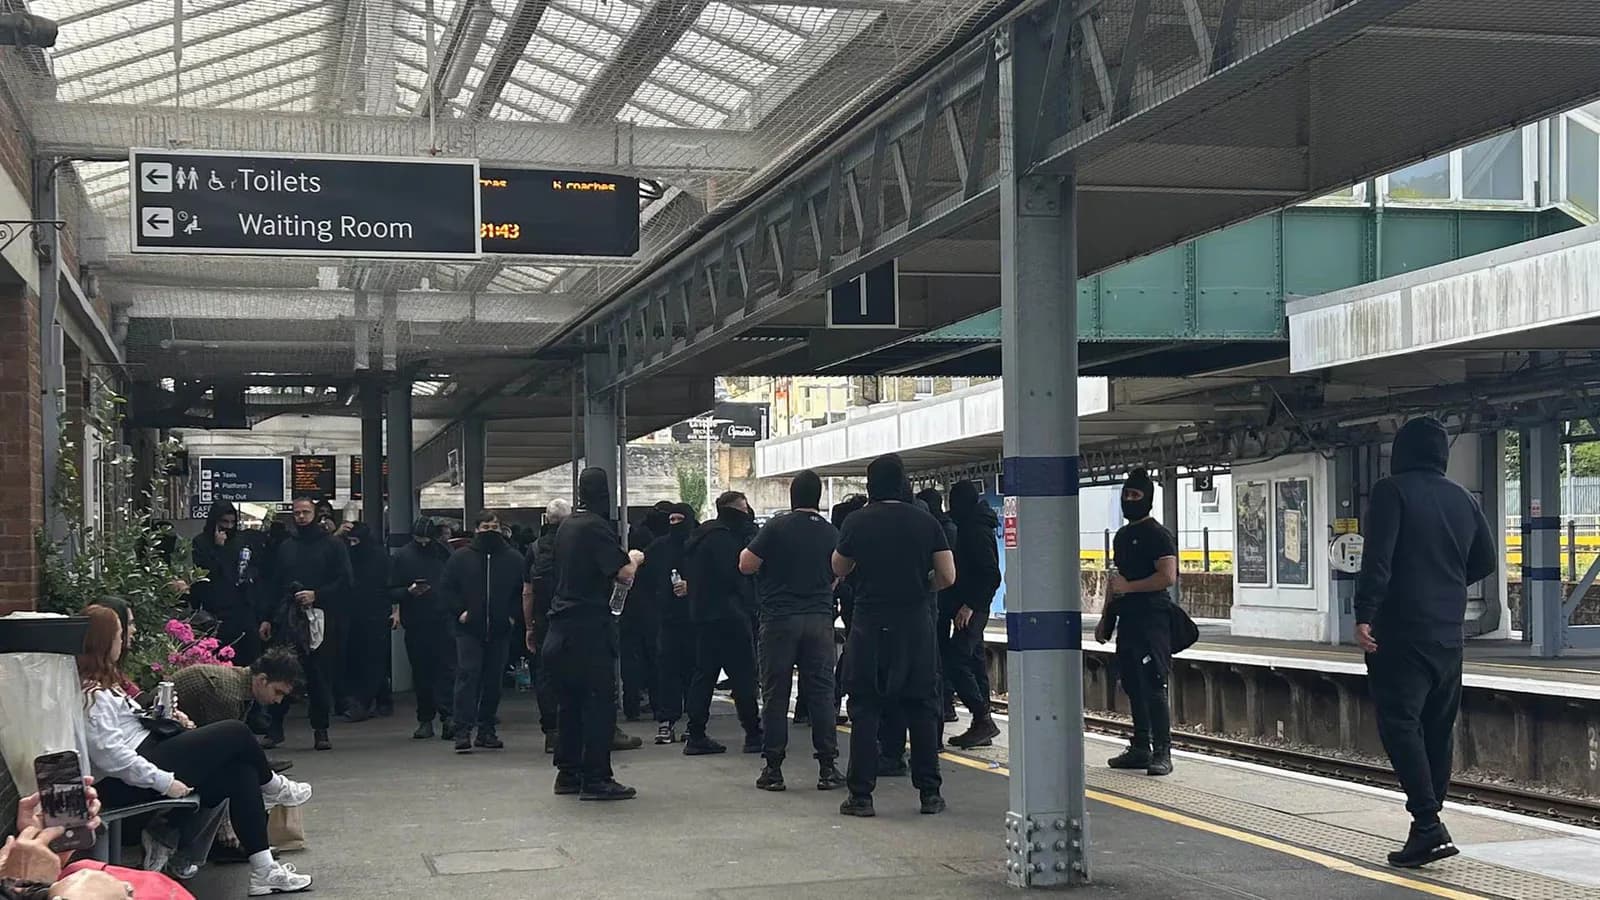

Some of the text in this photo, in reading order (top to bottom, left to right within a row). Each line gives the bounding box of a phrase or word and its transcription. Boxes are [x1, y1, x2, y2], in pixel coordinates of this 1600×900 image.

[238, 168, 321, 192] Toilets
[238, 213, 413, 242] Waiting Room
[1200, 476, 1209, 489] 3
